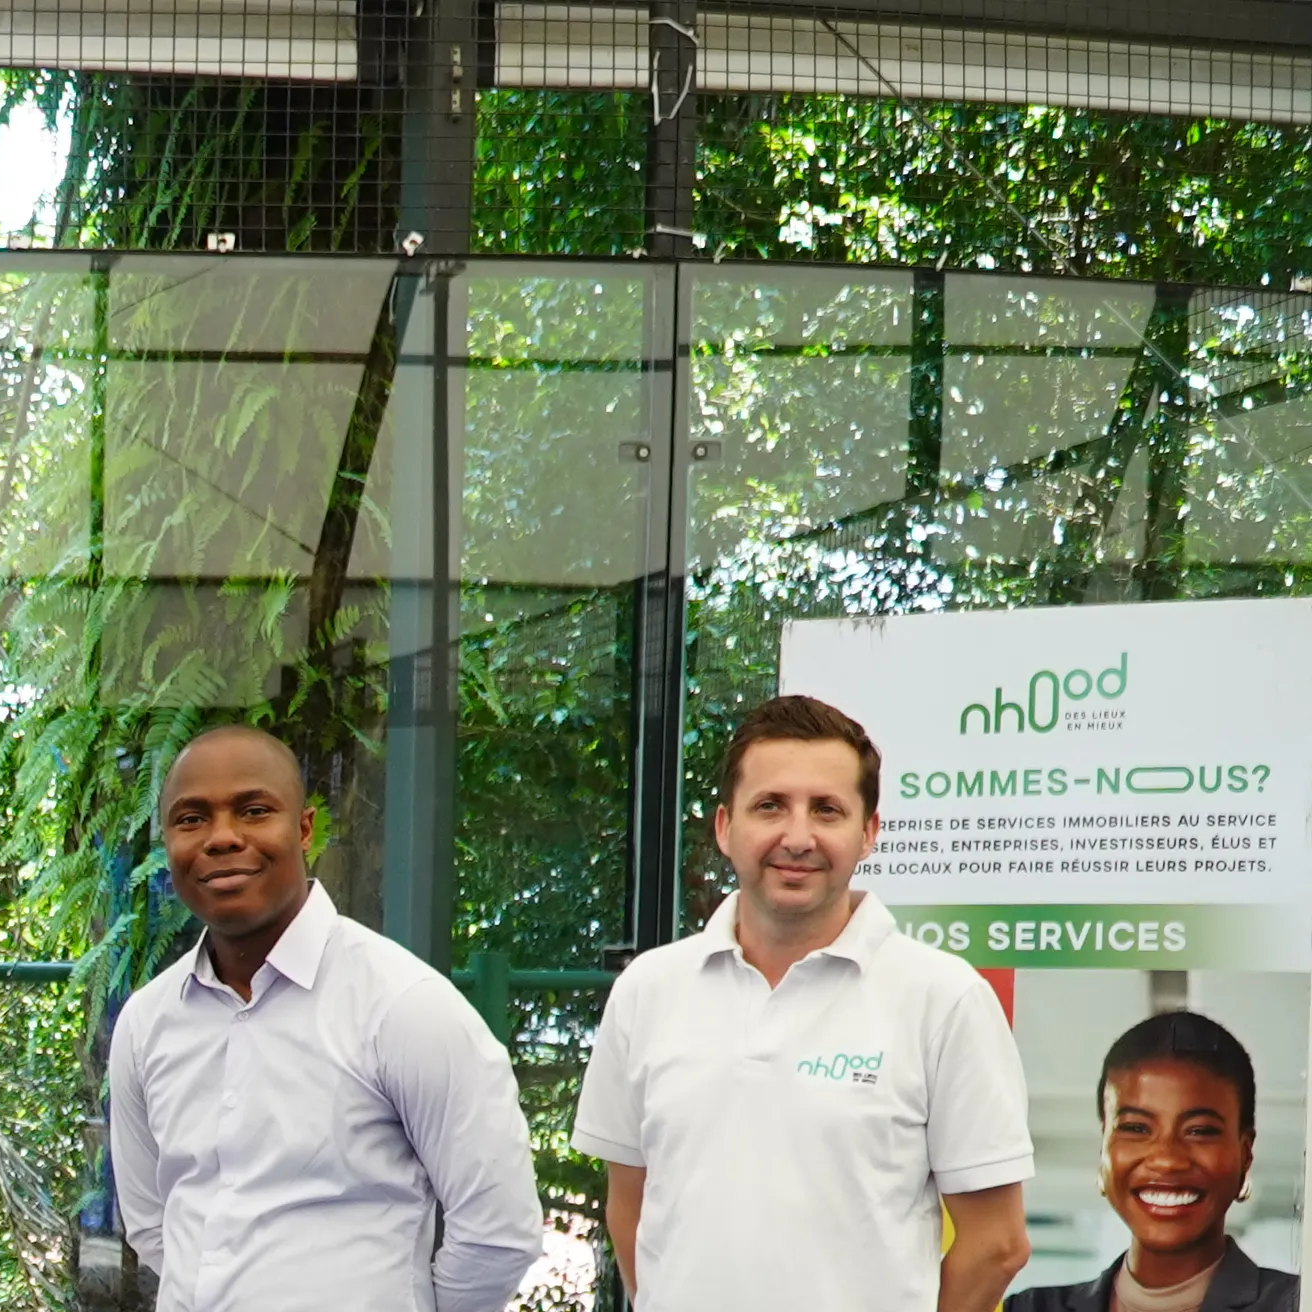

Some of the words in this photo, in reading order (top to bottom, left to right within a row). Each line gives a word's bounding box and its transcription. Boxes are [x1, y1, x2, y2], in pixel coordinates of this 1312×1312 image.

[1065, 711, 1087, 721] DES
[1092, 710, 1126, 720] LIEUX
[1067, 722, 1082, 731] EN
[1087, 721, 1123, 731] MIEUX
[950, 818, 970, 831] DE
[976, 816, 1056, 830] SERVICES
[1063, 815, 1171, 828] IMMOBILIERS
[1177, 814, 1200, 828] AU
[1206, 813, 1277, 828] SERVICE
[951, 839, 1064, 852] ENTREPRISES,
[1070, 837, 1204, 852] INVESTISSEURS,
[1211, 833, 1251, 850] ÉLUS
[1258, 836, 1277, 849] ET
[888, 862, 952, 875] LOCAUX
[958, 861, 1002, 874] POUR
[1009, 861, 1054, 873] FAIRE
[1061, 858, 1129, 873] RÉUSSIR
[1136, 859, 1187, 873] LEURS
[1194, 859, 1272, 873] PROJETS.
[987, 920, 1186, 951] SERVICES
